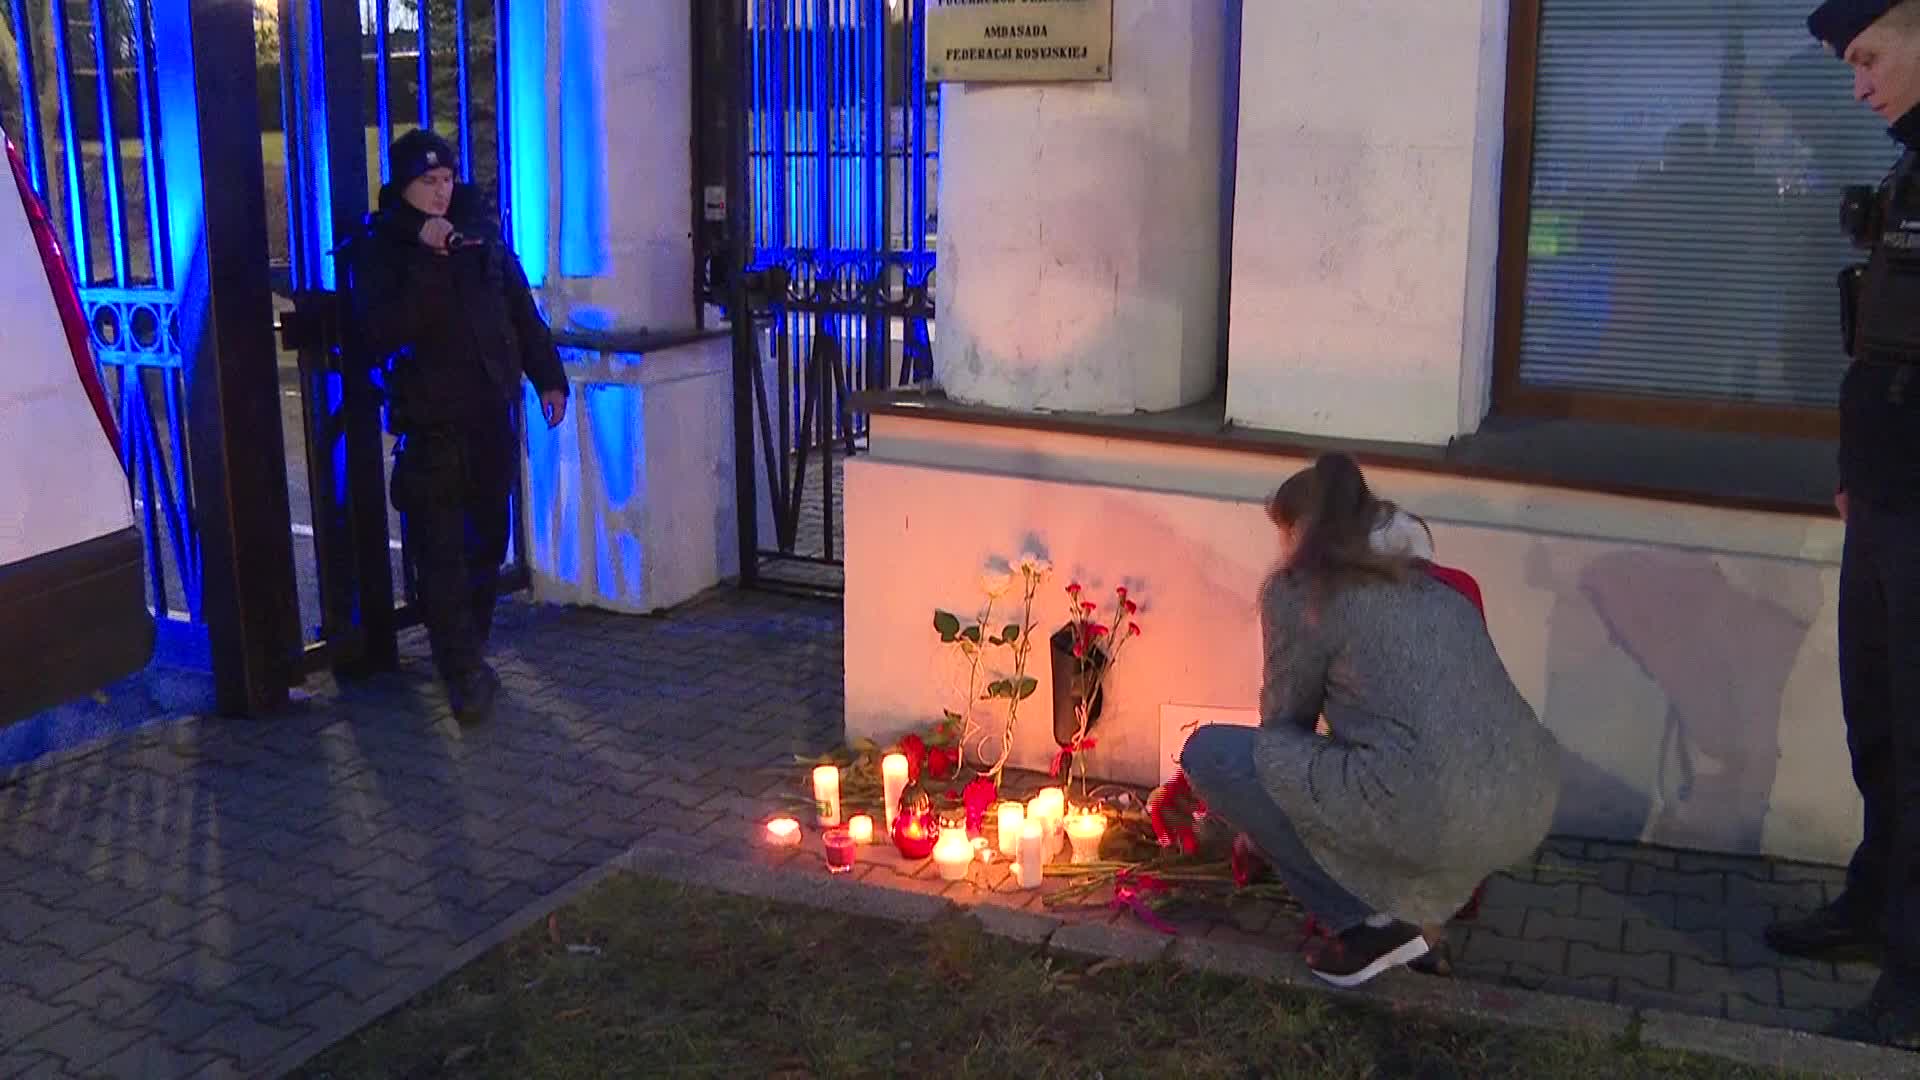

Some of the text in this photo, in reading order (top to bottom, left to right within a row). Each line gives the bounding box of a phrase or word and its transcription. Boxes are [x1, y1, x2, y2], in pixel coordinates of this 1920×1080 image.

[983, 24, 1048, 39] AMBASADA
[945, 46, 1088, 61] FEDERACJI ROSYJSKIEJ
